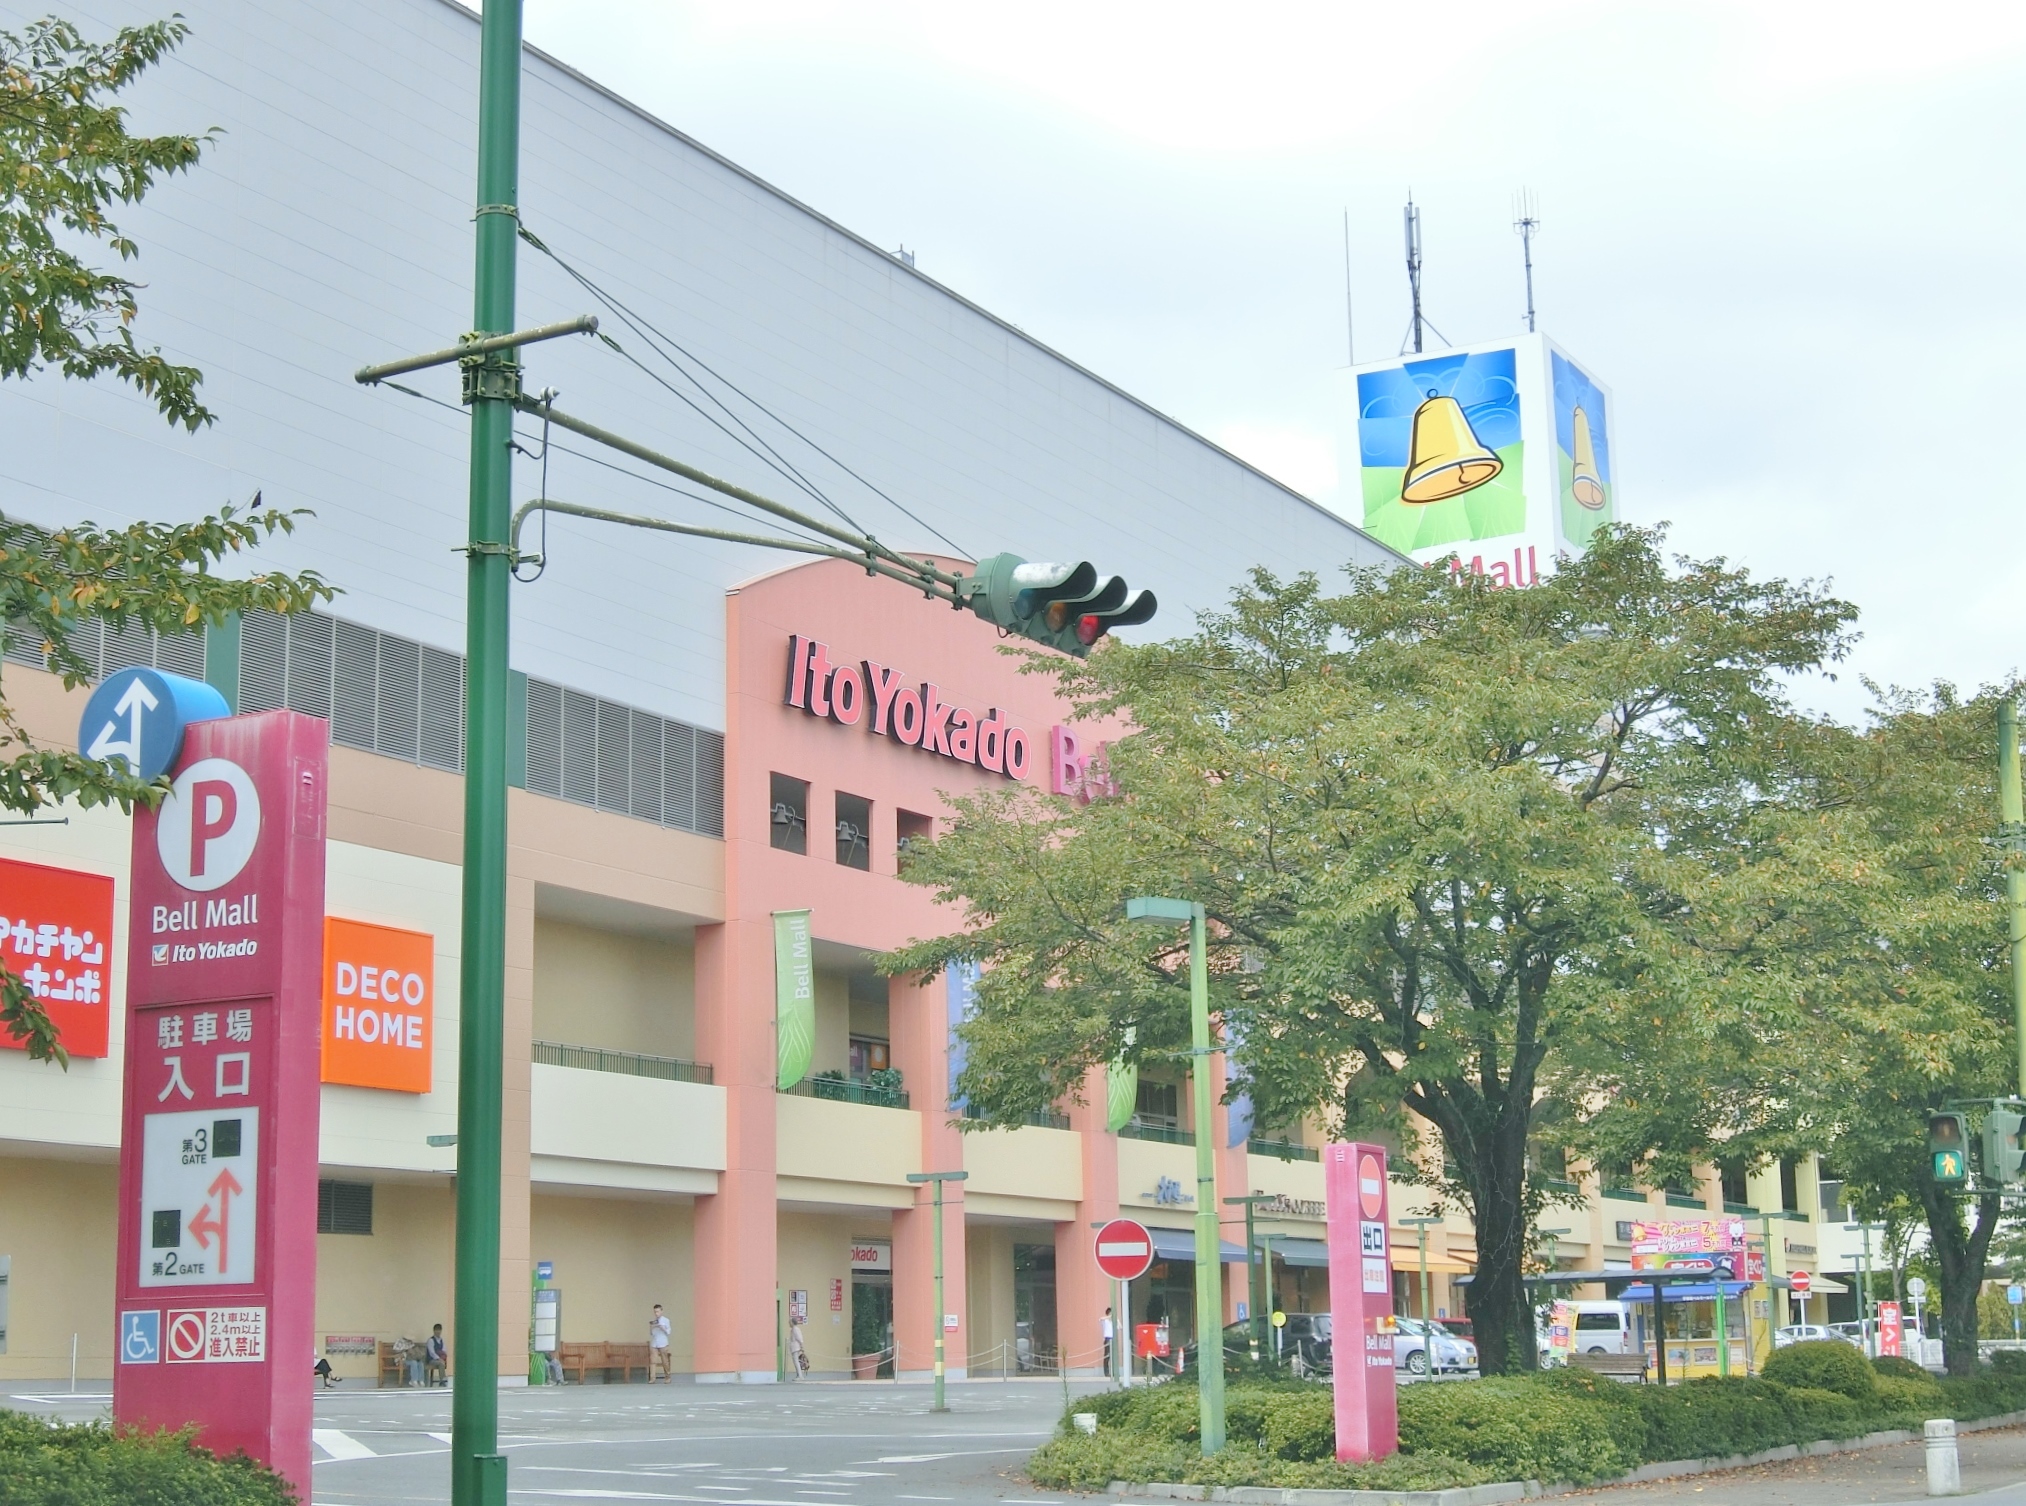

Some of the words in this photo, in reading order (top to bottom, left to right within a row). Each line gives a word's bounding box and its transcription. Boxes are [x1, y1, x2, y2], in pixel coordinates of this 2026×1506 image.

[189, 779, 237, 877] P
[152, 900, 198, 933] Bell
[205, 894, 258, 928] Mall
[172, 944, 196, 963] Ito
[197, 938, 258, 960] Yokado
[790, 918, 808, 958] Mall
[336, 961, 425, 1005] DECO
[793, 963, 810, 999] Bell
[158, 1009, 252, 1049] 駐車場
[335, 1009, 423, 1049] HOME
[157, 1052, 250, 1103] 入口
[182, 1128, 208, 1153] 第3
[182, 1154, 207, 1165] GATE
[1363, 1225, 1383, 1251] 出口
[152, 1252, 178, 1276] 第2
[179, 1264, 205, 1275] GATE
[210, 1311, 262, 1323] 2t車以上
[210, 1324, 261, 1335] 2.4m以上
[209, 1336, 260, 1358] 進入禁止
[1366, 1334, 1378, 1350] Bell
[1378, 1334, 1392, 1350] Mall
